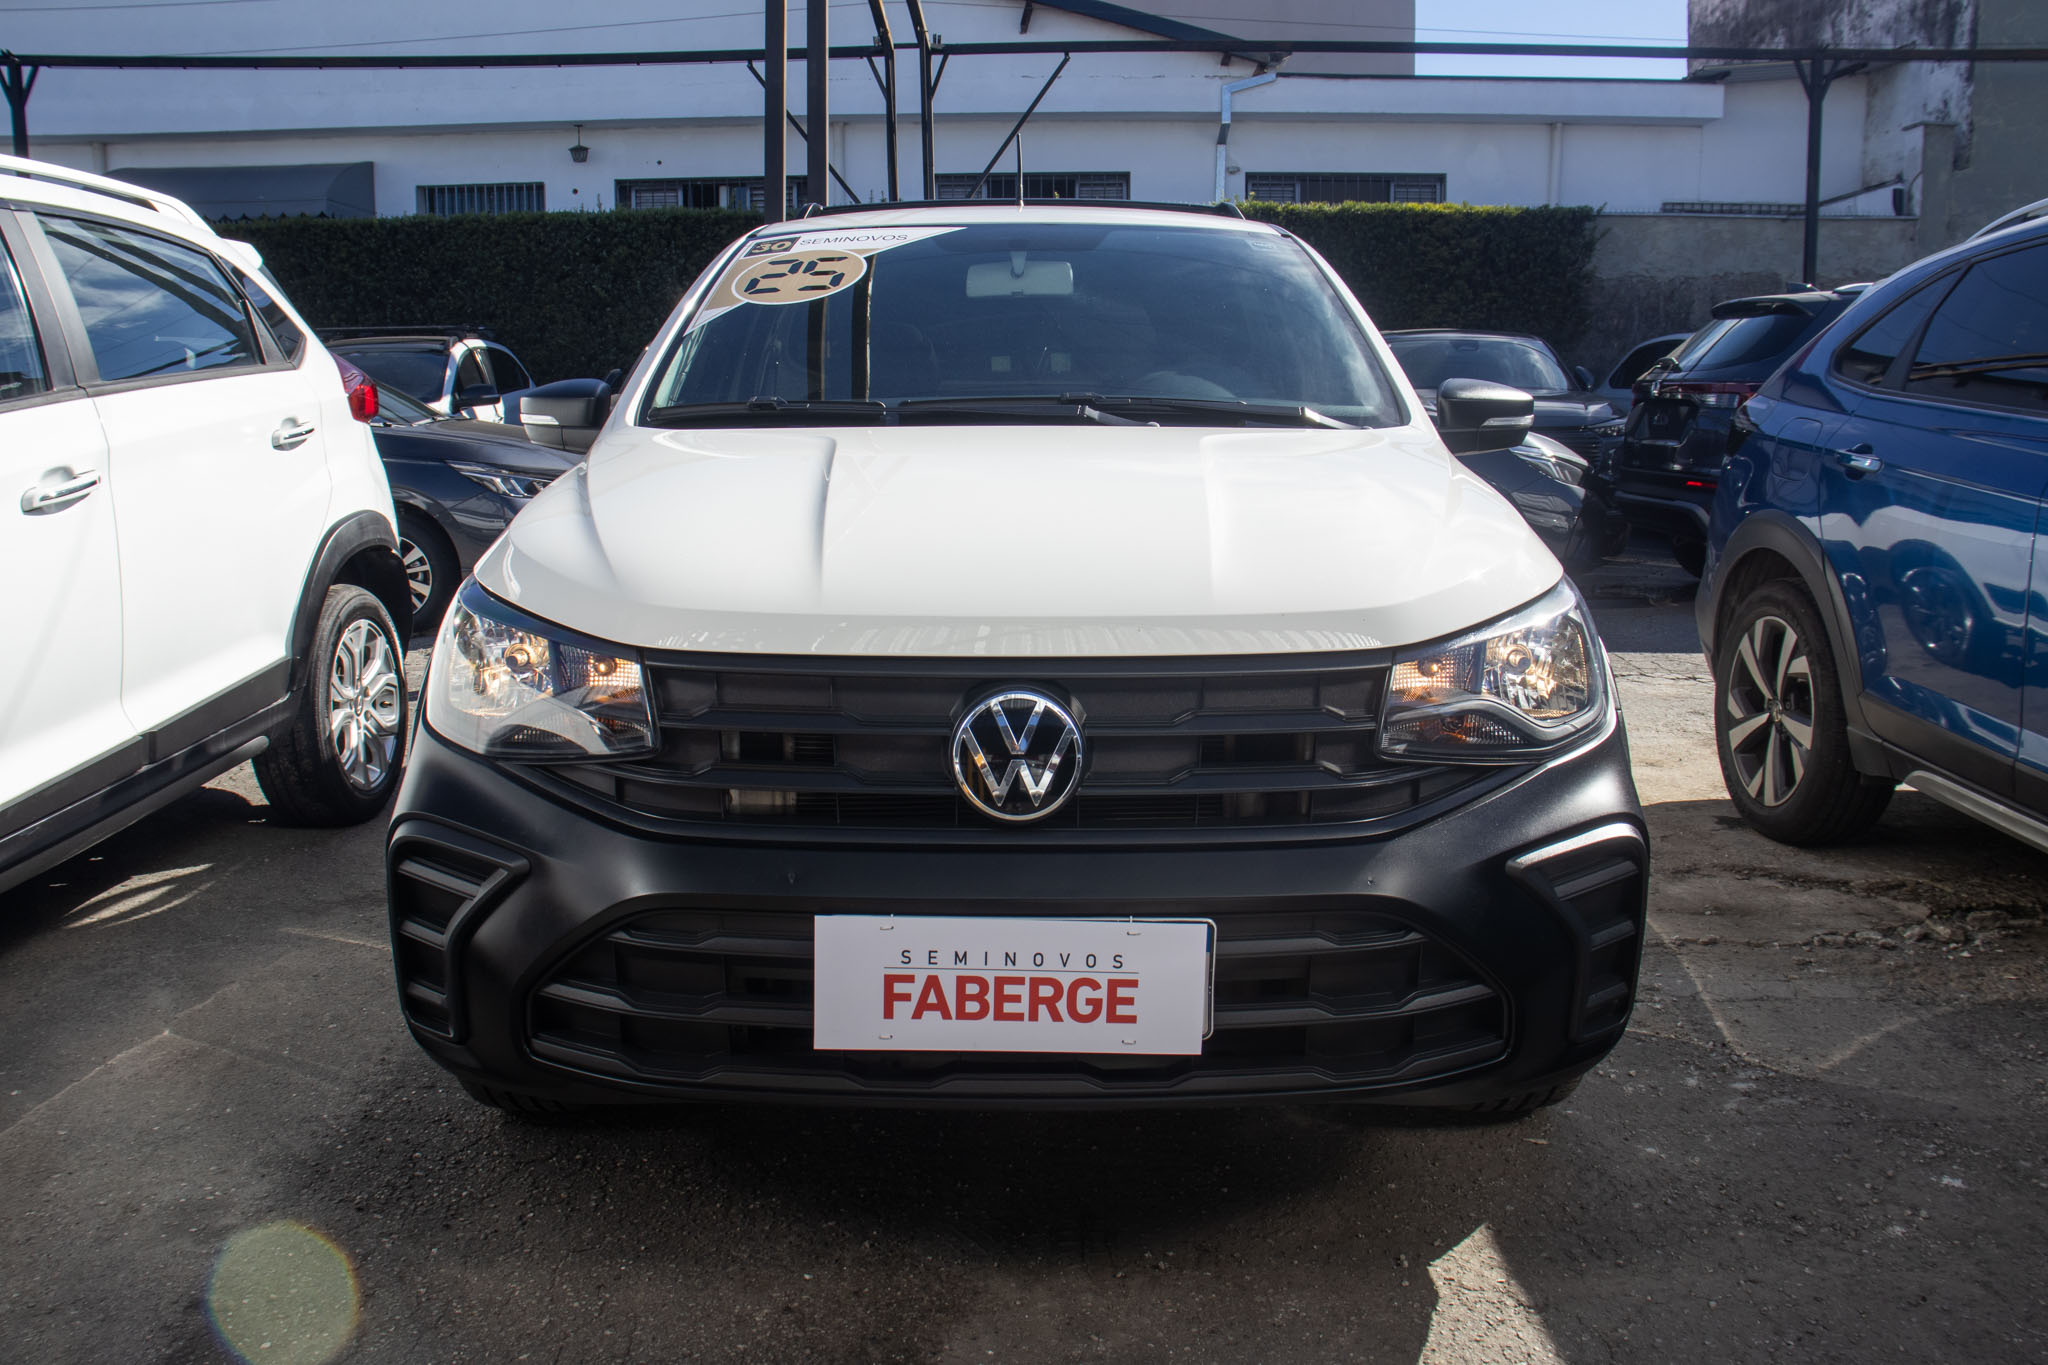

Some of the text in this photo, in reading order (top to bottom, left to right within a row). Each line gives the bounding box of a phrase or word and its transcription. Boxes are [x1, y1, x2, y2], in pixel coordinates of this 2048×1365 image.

[801, 234, 908, 246] SEMINOVOS
[744, 256, 849, 294] 25
[956, 696, 1079, 808] VW
[900, 949, 1124, 969] SEMINOVOS
[883, 973, 1139, 1024] FABERGE
